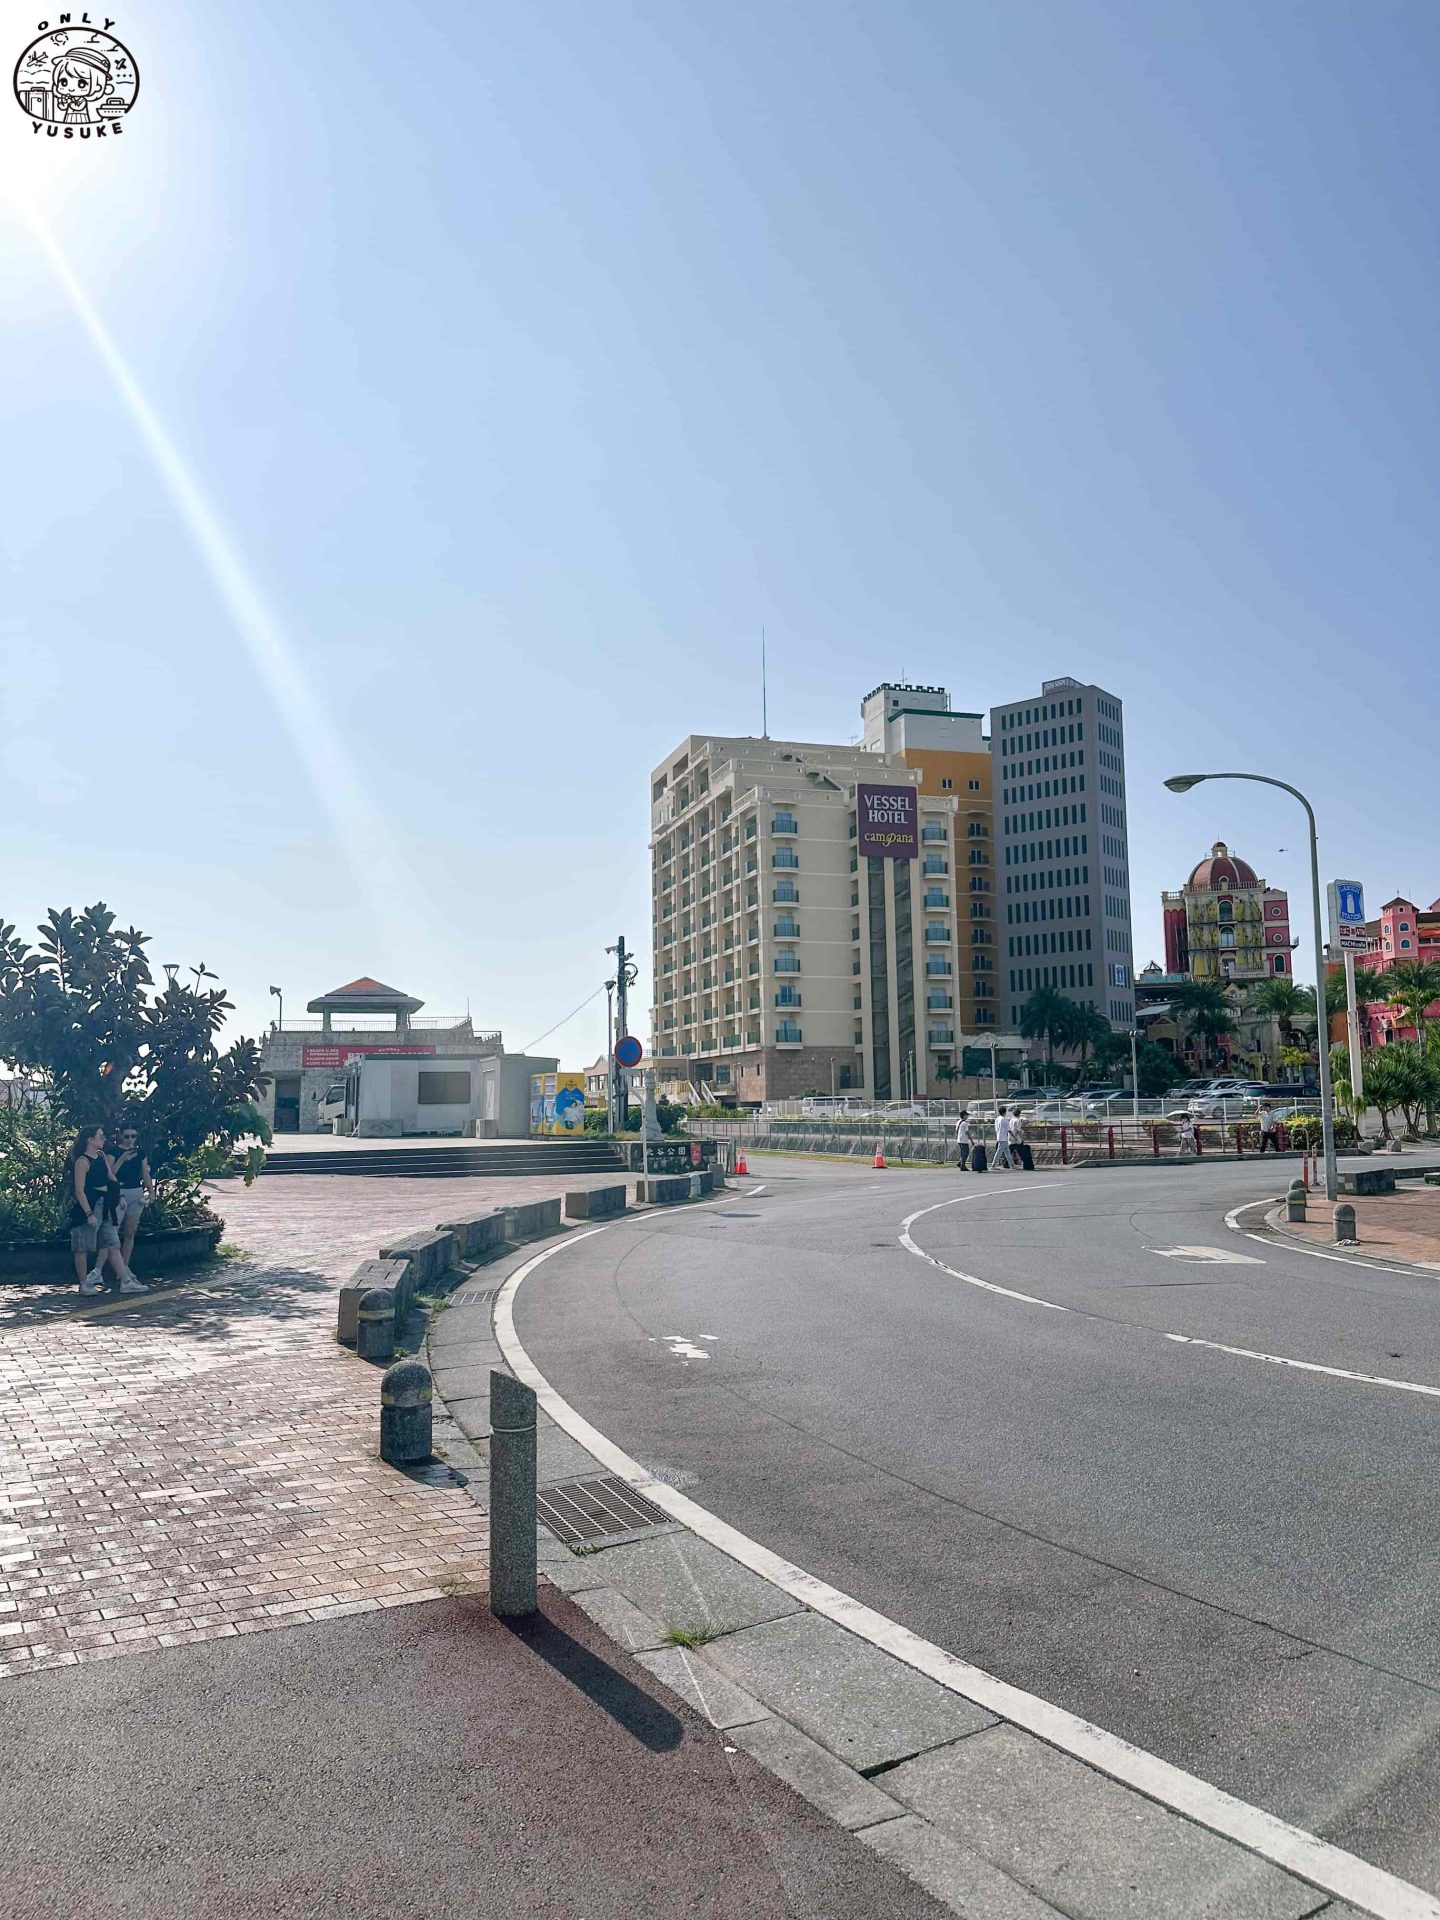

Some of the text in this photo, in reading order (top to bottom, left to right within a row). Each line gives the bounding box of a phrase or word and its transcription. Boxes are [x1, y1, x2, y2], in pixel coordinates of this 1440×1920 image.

[864, 795, 913, 811] VESSEL
[868, 810, 908, 824] HOTEL
[864, 831, 914, 848] campana
